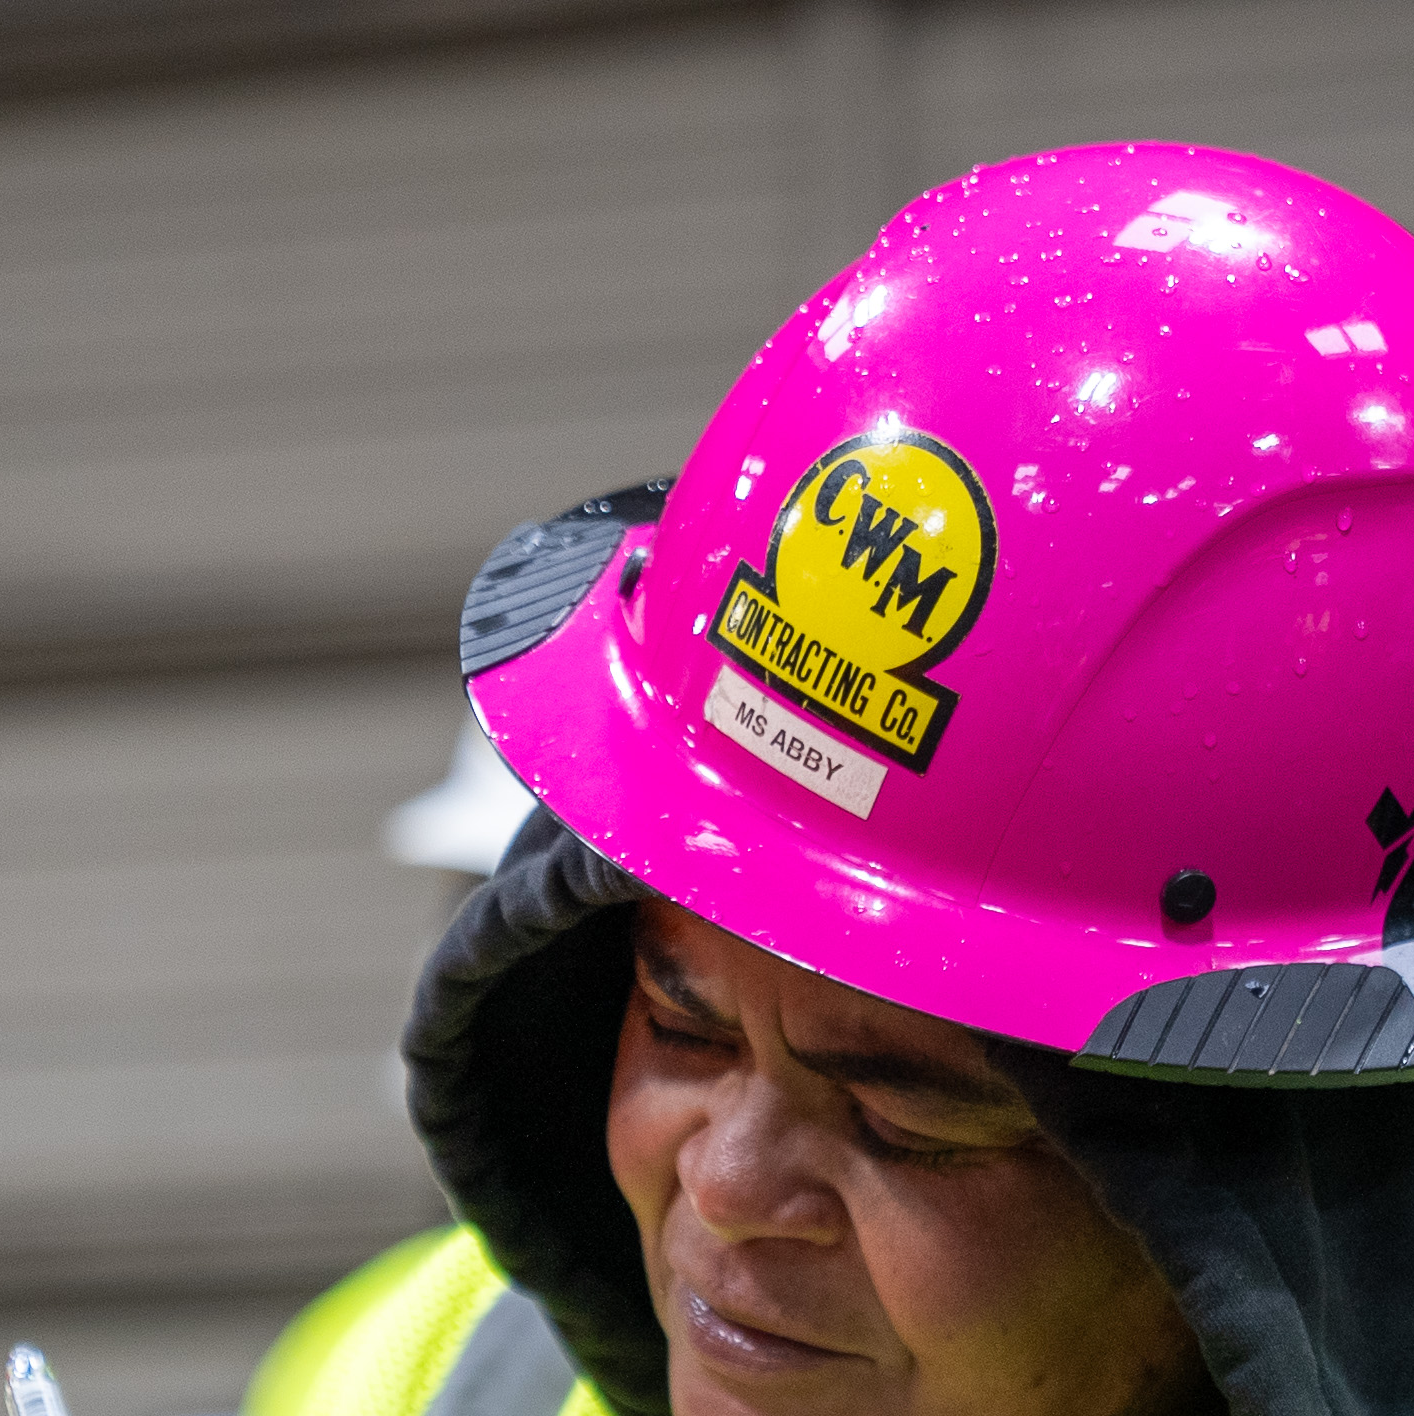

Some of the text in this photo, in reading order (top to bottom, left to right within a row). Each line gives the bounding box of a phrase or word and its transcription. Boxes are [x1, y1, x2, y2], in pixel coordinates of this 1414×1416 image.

[727, 590, 916, 745] CONTRACTING Co.
[734, 701, 845, 781] MS ABBY
